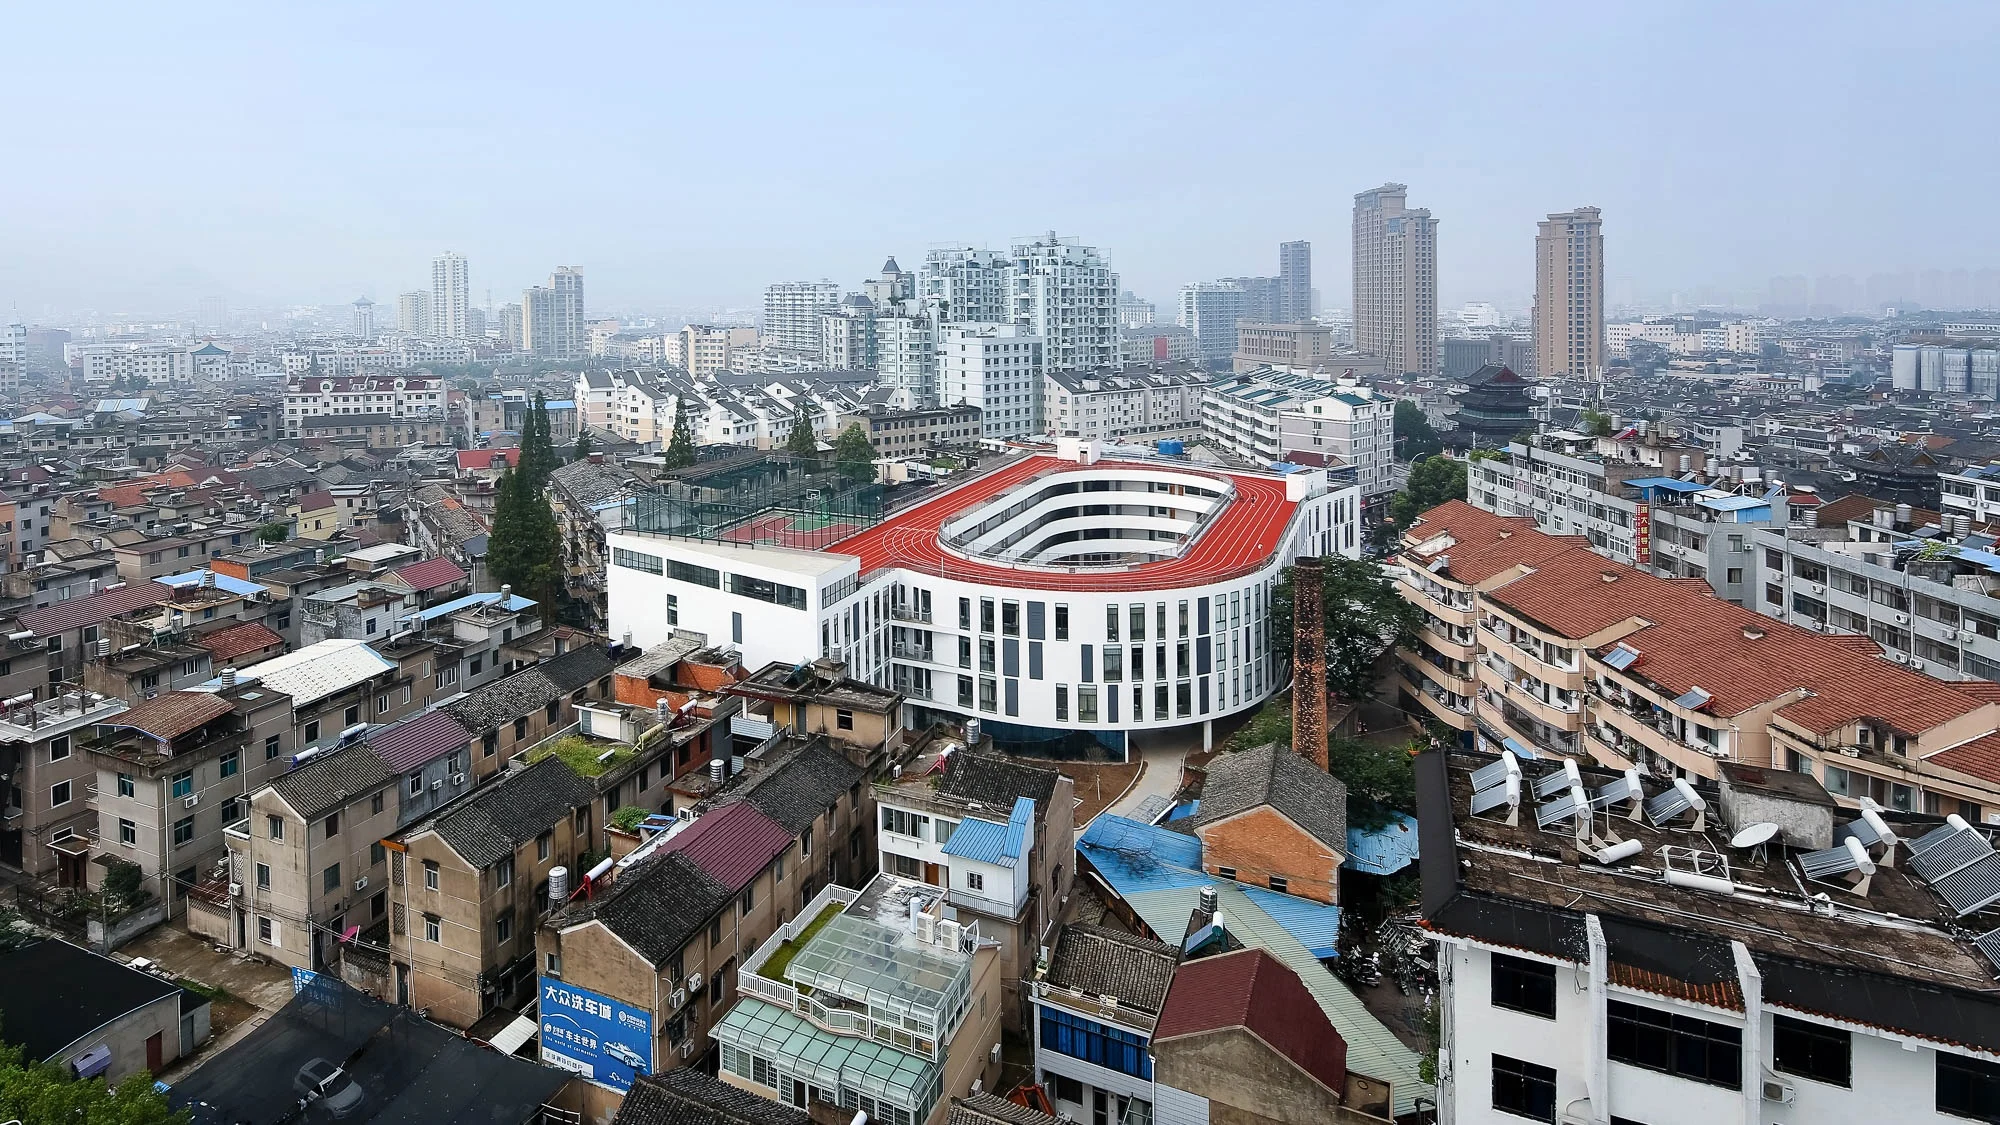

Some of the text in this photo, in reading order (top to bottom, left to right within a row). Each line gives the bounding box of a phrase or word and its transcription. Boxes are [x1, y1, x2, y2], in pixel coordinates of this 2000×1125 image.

[545, 985, 612, 1021] 大众洗车城
[565, 1030, 598, 1050] 车主世界
